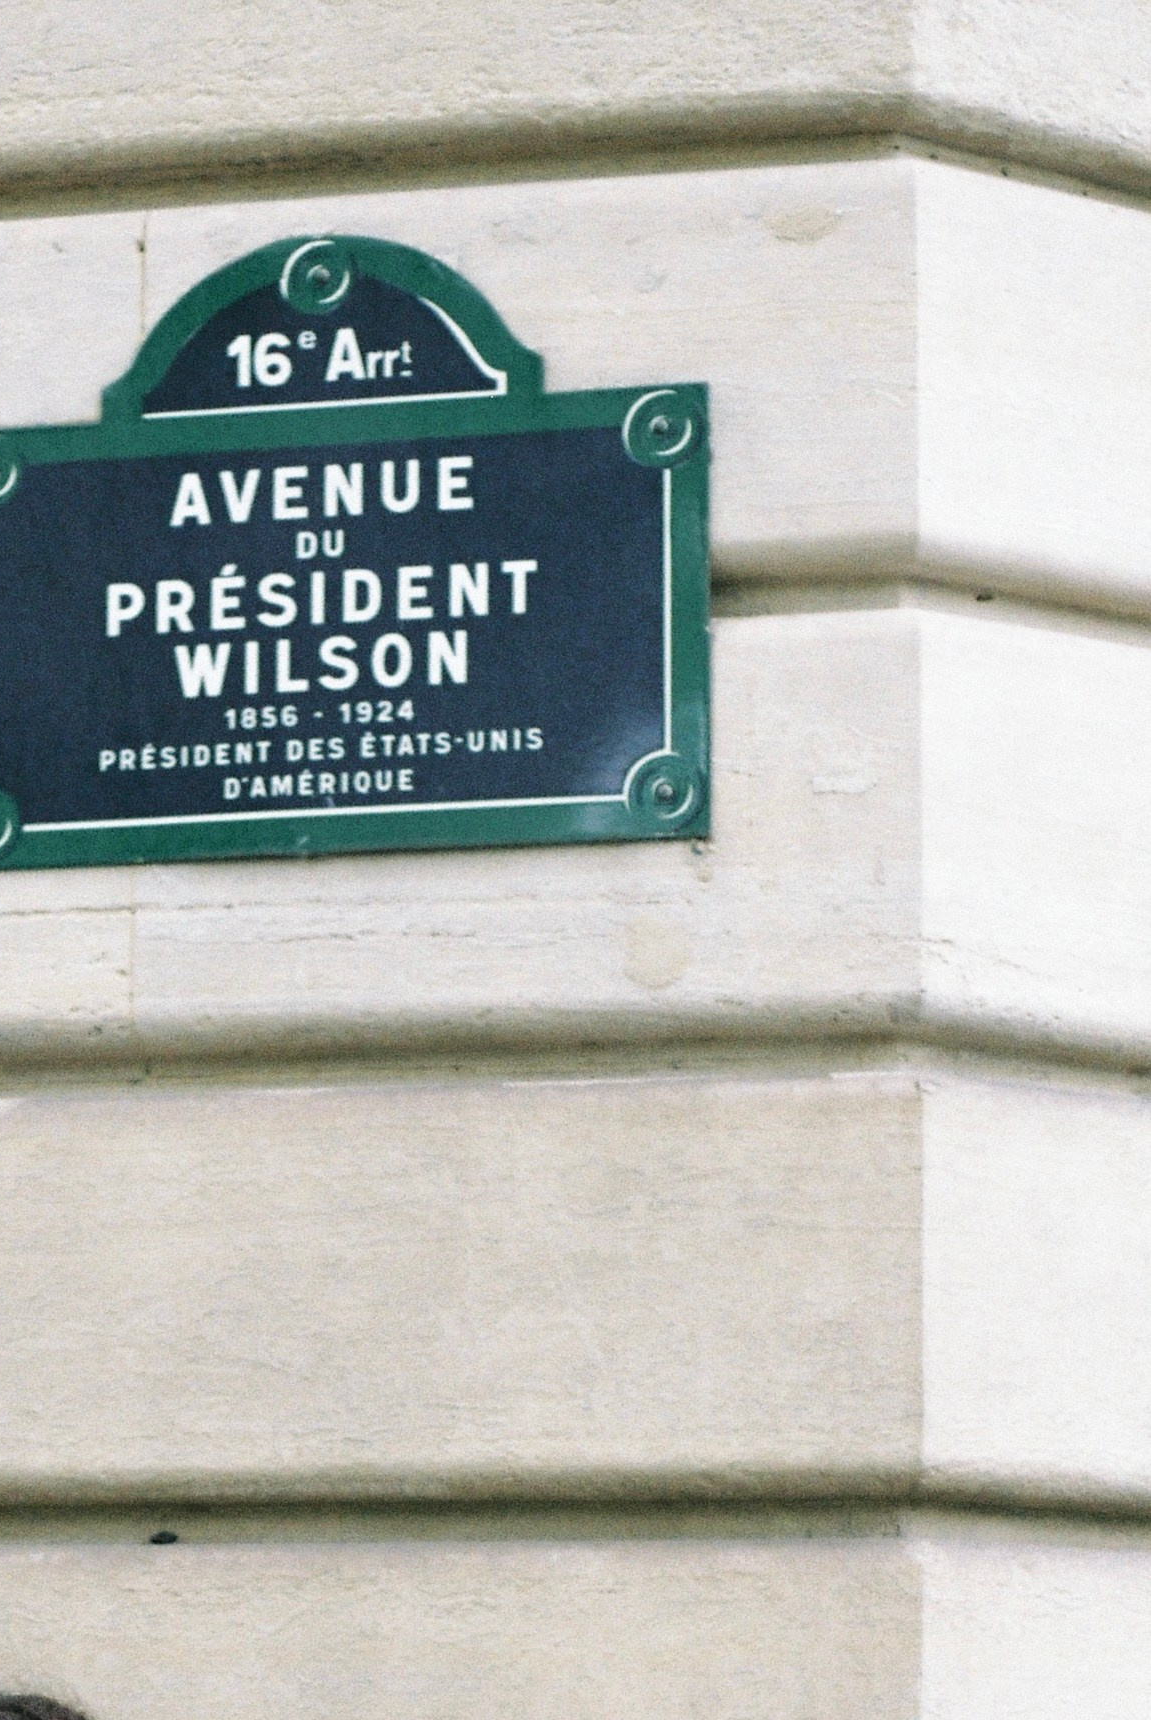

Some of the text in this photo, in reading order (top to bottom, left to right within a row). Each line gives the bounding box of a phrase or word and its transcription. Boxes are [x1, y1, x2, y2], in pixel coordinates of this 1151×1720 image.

[170, 455, 474, 528] AVENUE
[296, 529, 346, 560] DU
[106, 559, 538, 637] PRÉSIDENT
[174, 629, 468, 699] WILSON
[224, 701, 299, 730] 1856
[339, 699, 415, 725] 1924
[98, 727, 545, 772] PRÉSIDENT DES ÉTATS-UNIS
